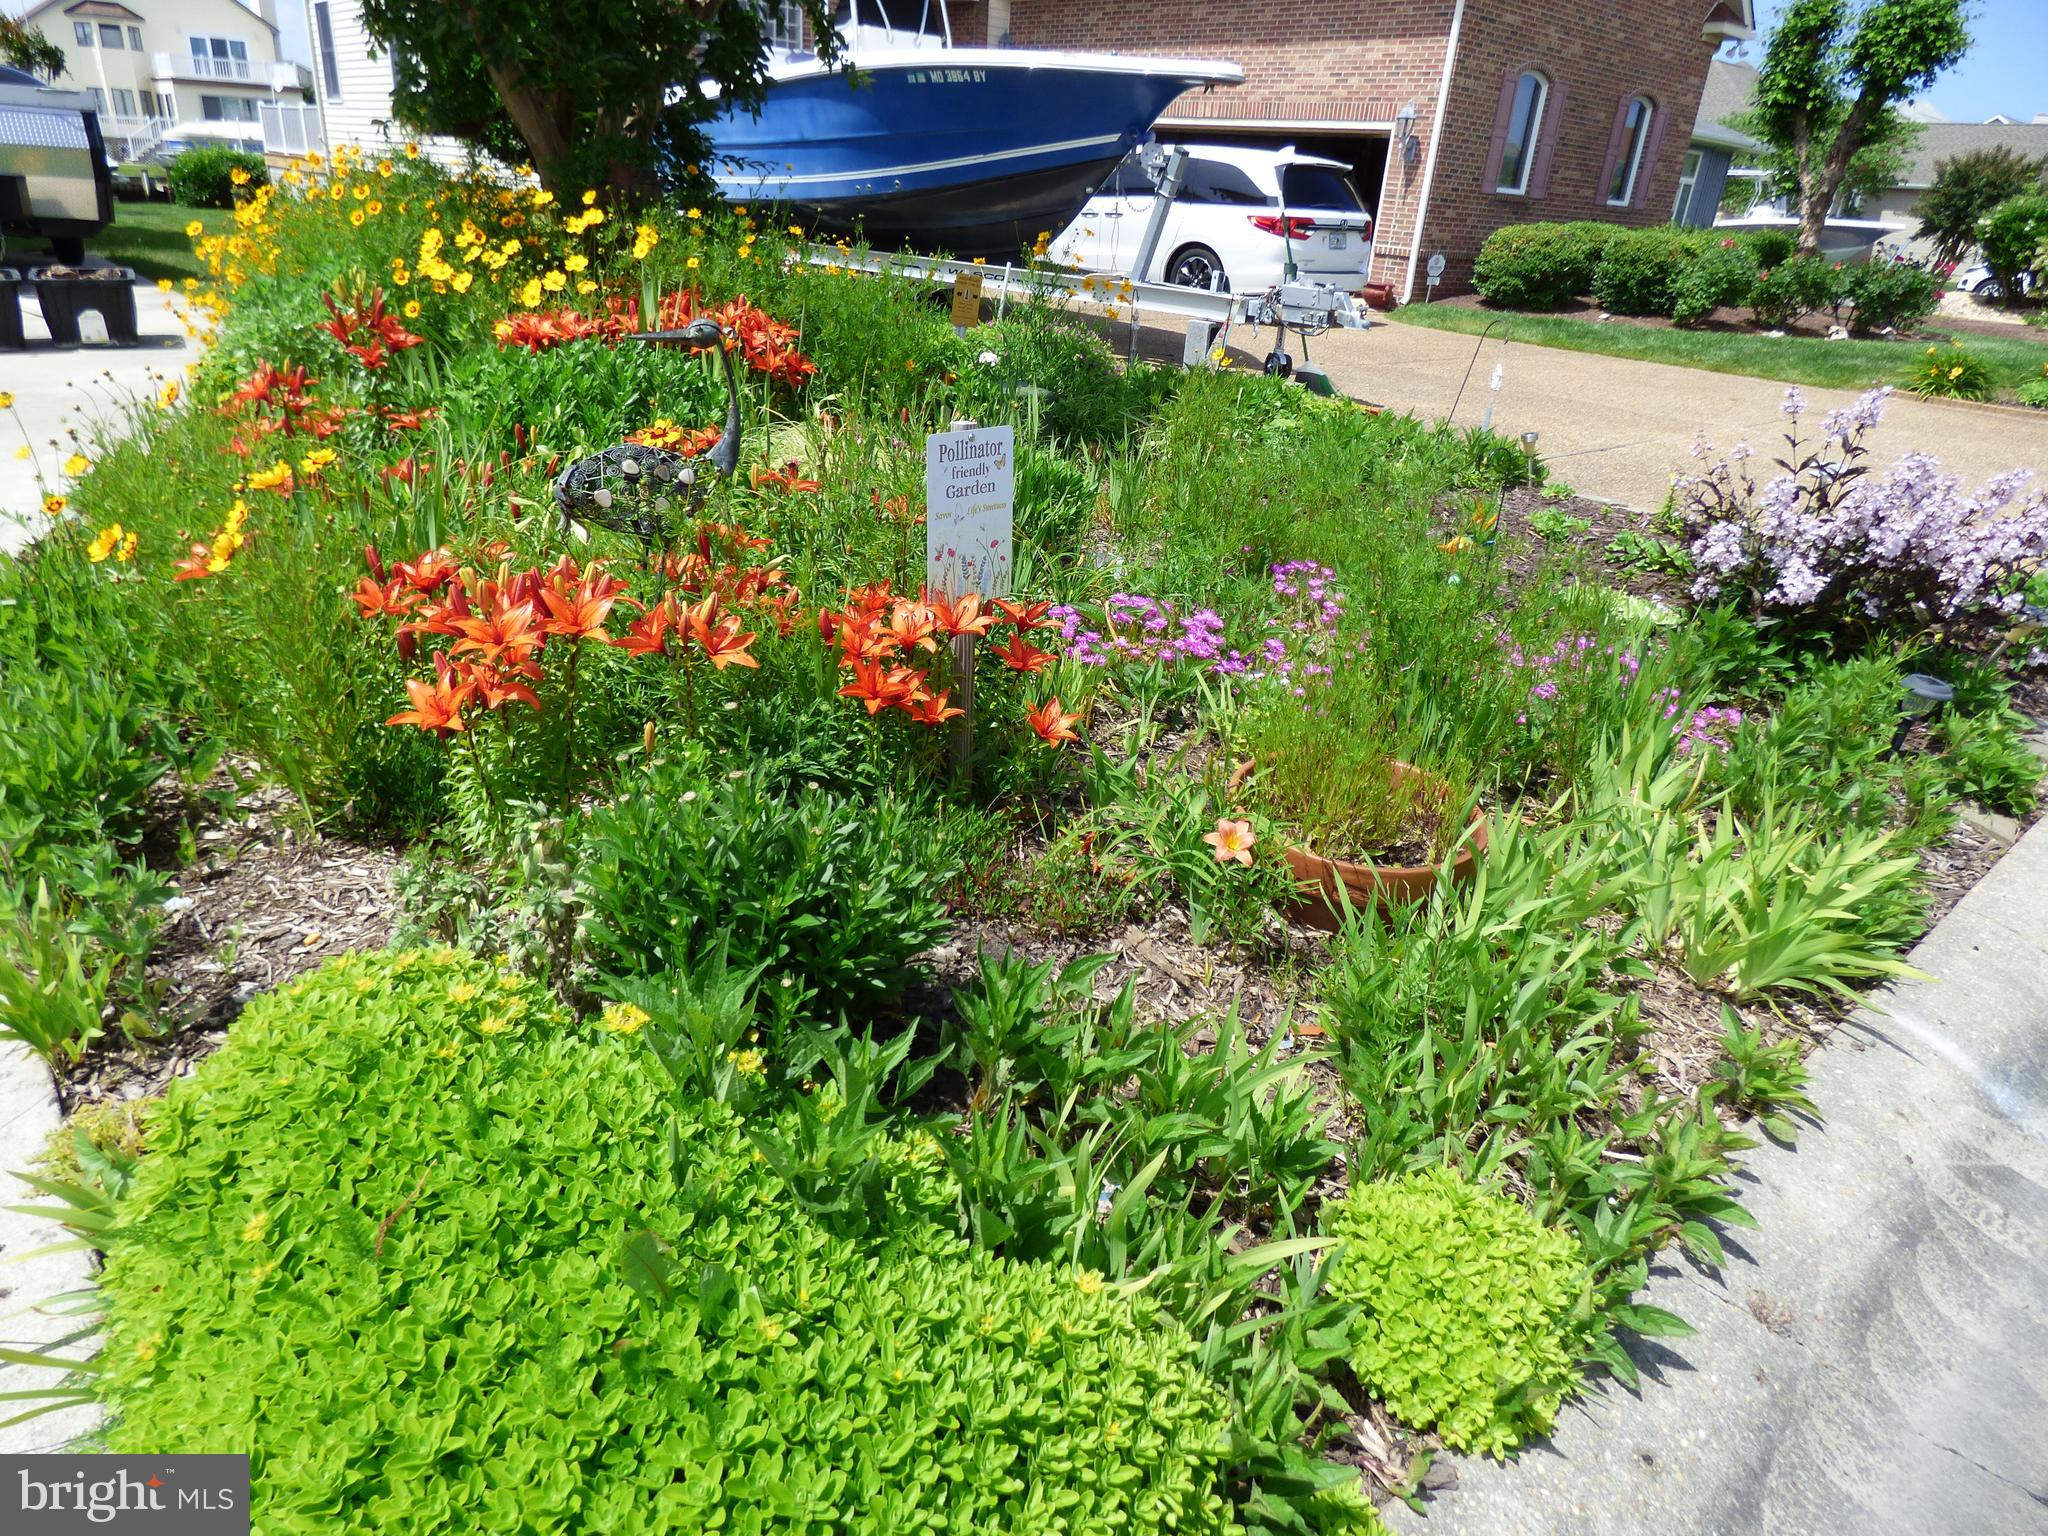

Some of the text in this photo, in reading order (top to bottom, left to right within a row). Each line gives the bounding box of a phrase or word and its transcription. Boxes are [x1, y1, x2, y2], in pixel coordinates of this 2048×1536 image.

[939, 440, 1003, 463] Pollinator
[952, 463, 991, 479] friendly
[946, 480, 995, 499] Garden
